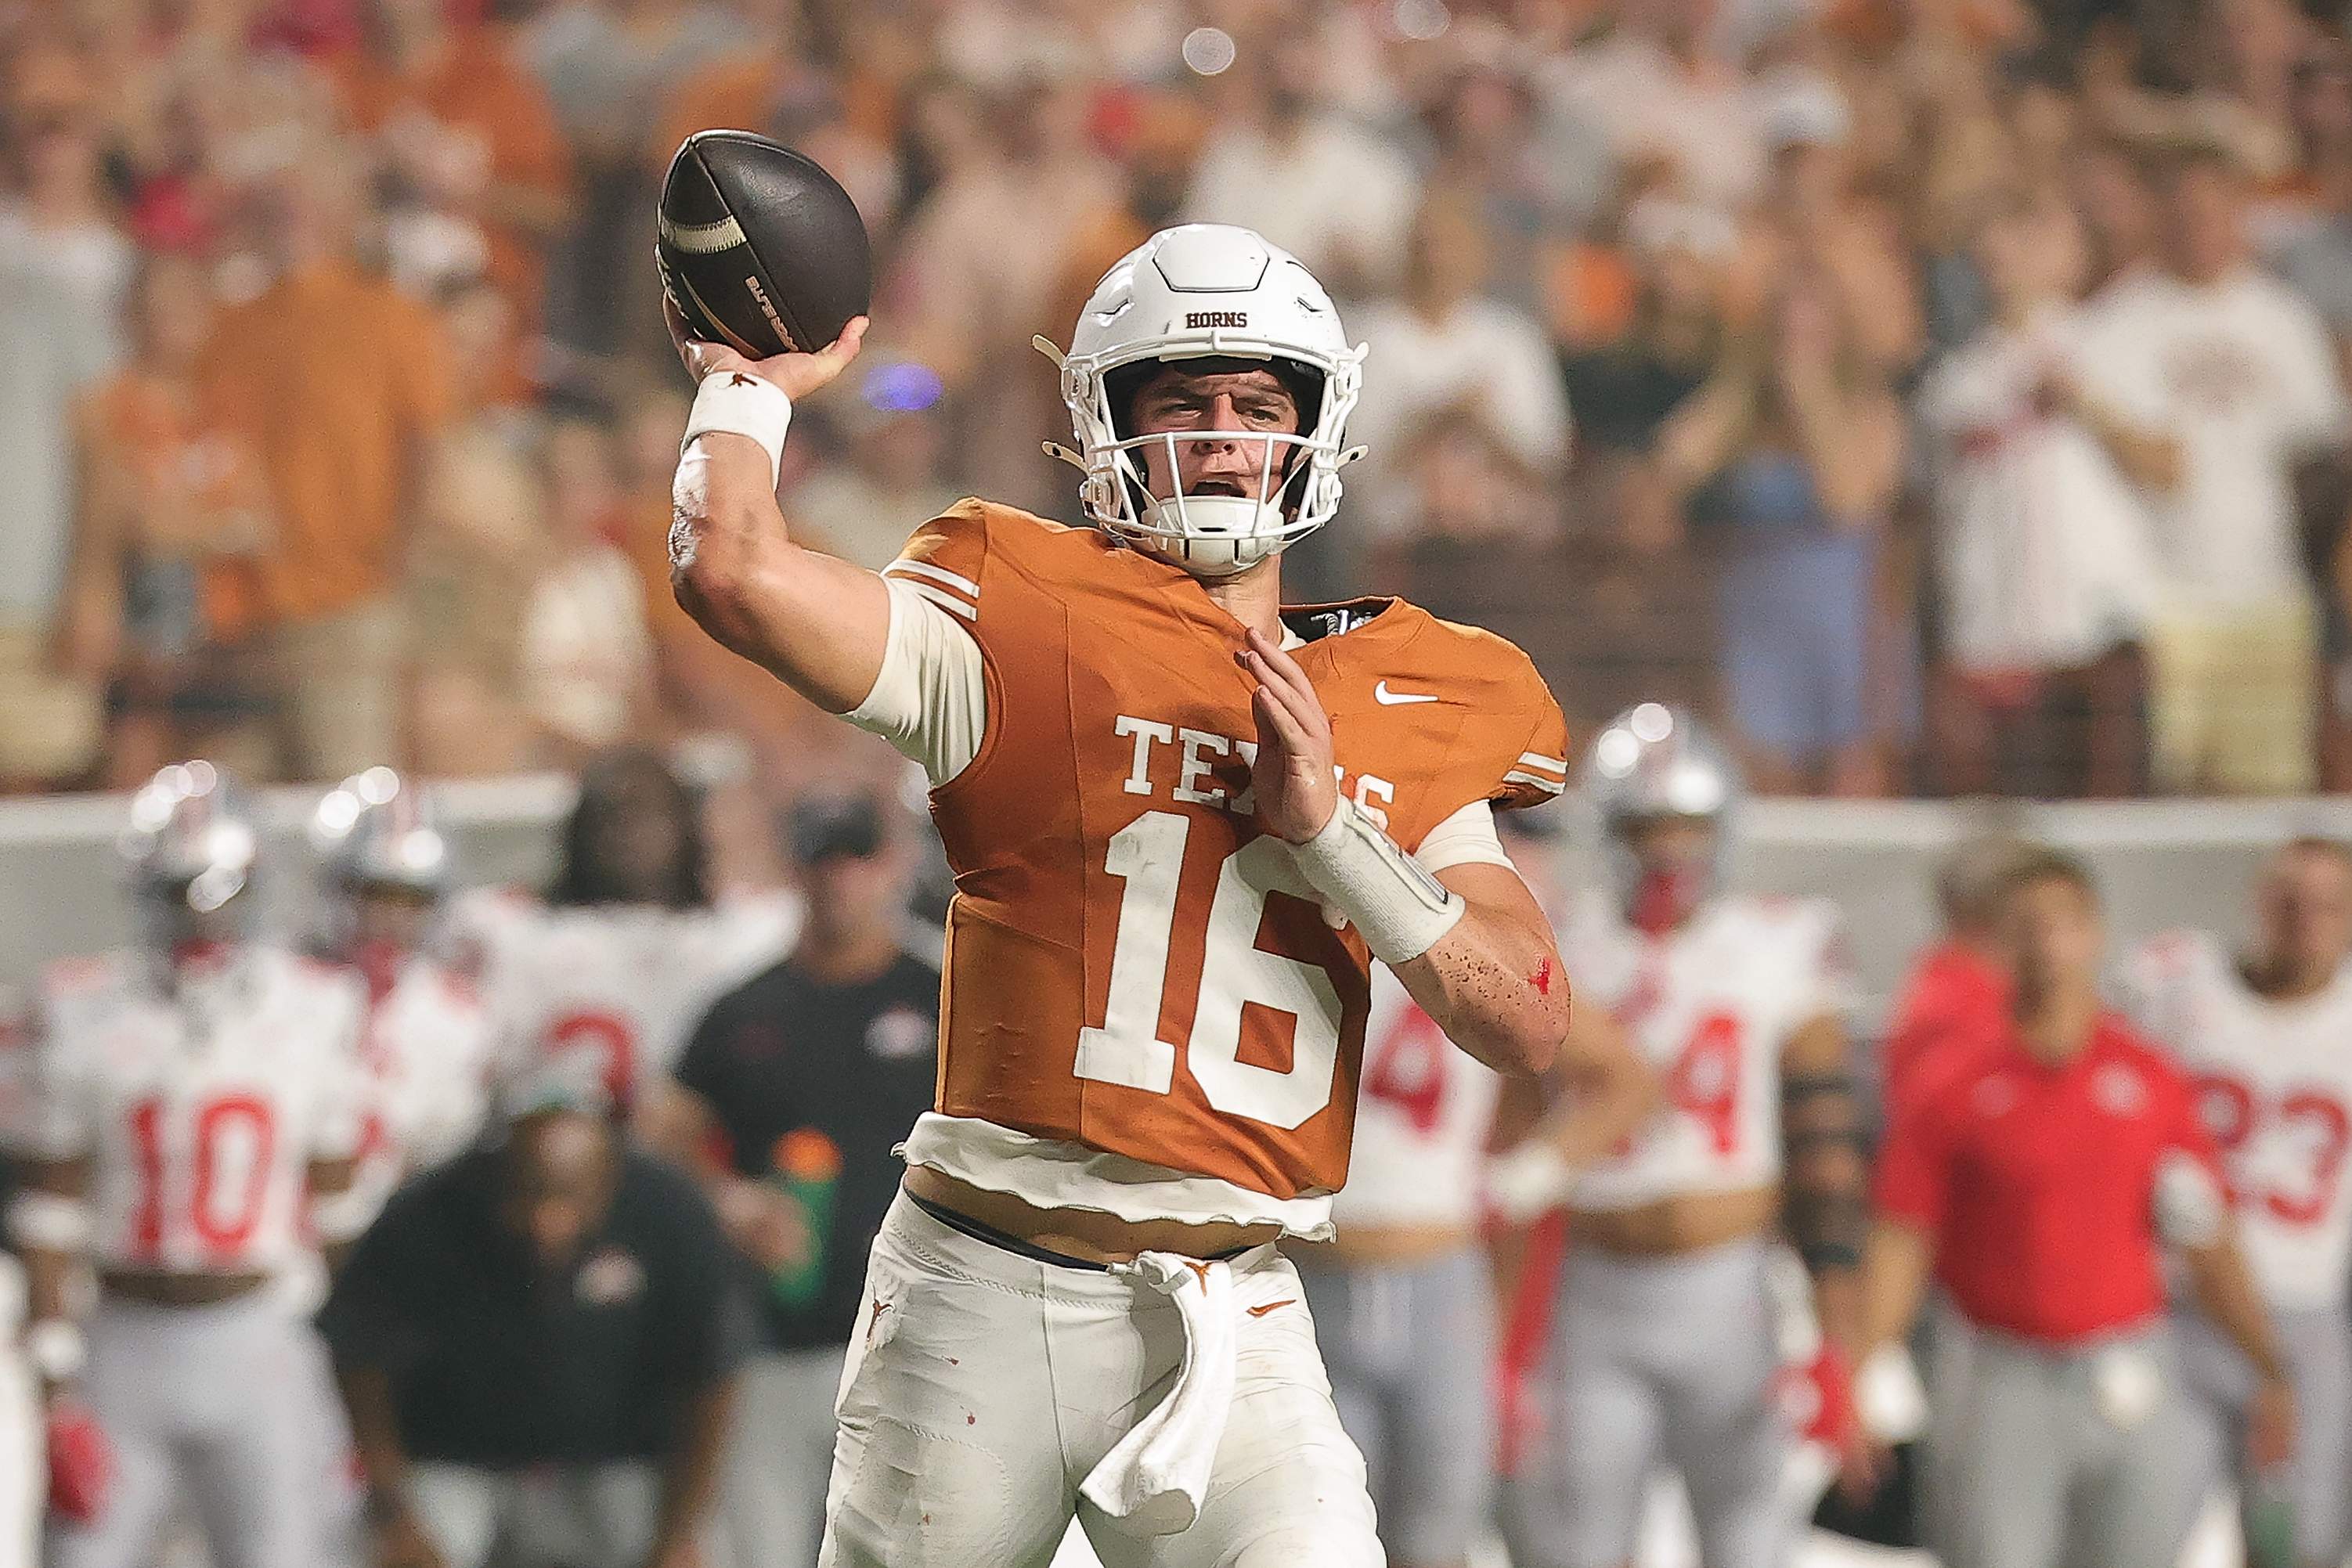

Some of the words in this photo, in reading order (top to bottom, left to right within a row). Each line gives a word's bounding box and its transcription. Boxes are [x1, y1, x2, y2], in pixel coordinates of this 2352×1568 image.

[1185, 312, 1247, 329] HORNS
[1114, 714, 1394, 832] TES
[1073, 810, 1344, 1130] 16
[127, 1092, 277, 1257] 10
